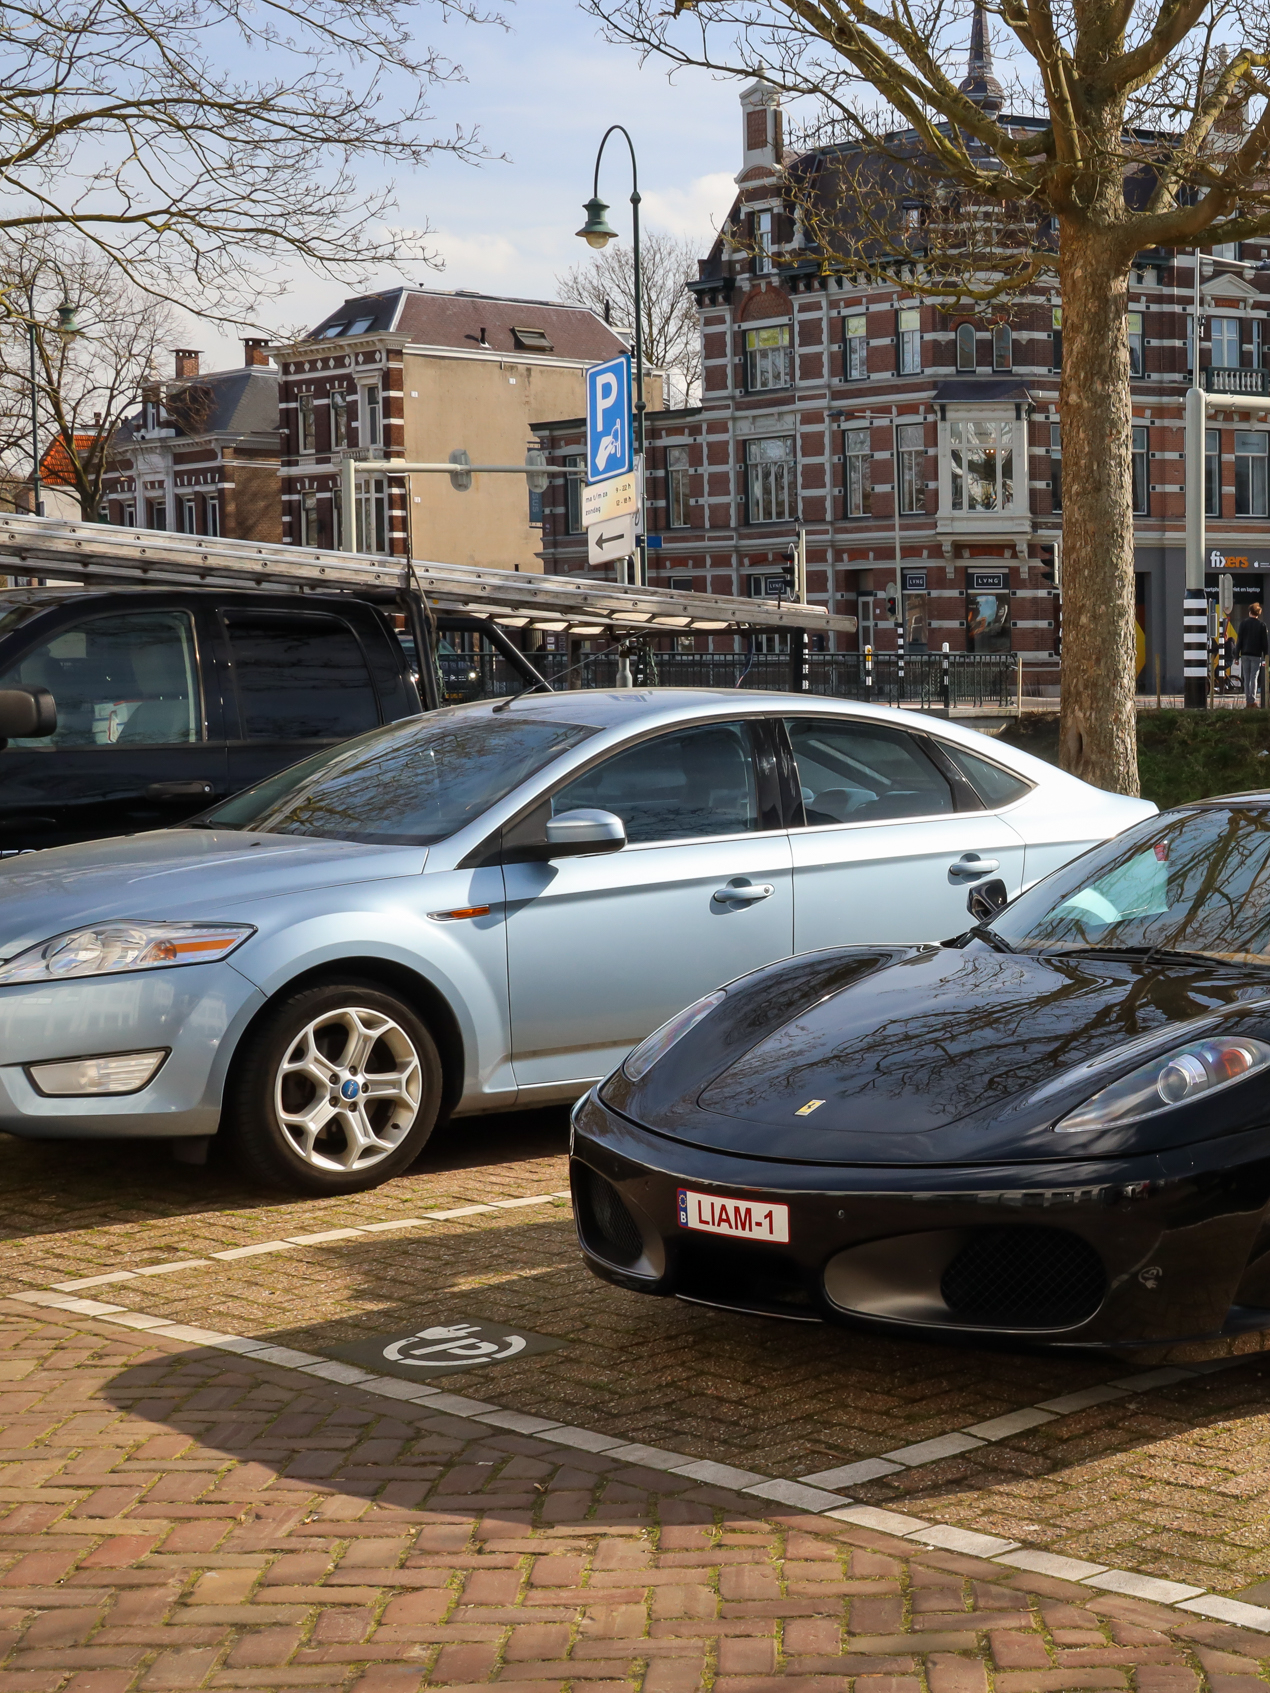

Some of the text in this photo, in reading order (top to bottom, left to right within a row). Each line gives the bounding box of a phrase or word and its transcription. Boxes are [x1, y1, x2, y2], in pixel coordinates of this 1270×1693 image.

[595, 371, 618, 432] P
[585, 506, 601, 516] zondag
[1210, 550, 1249, 568] fixers
[680, 1211, 687, 1223] B
[697, 1199, 774, 1235] LIAM-1
